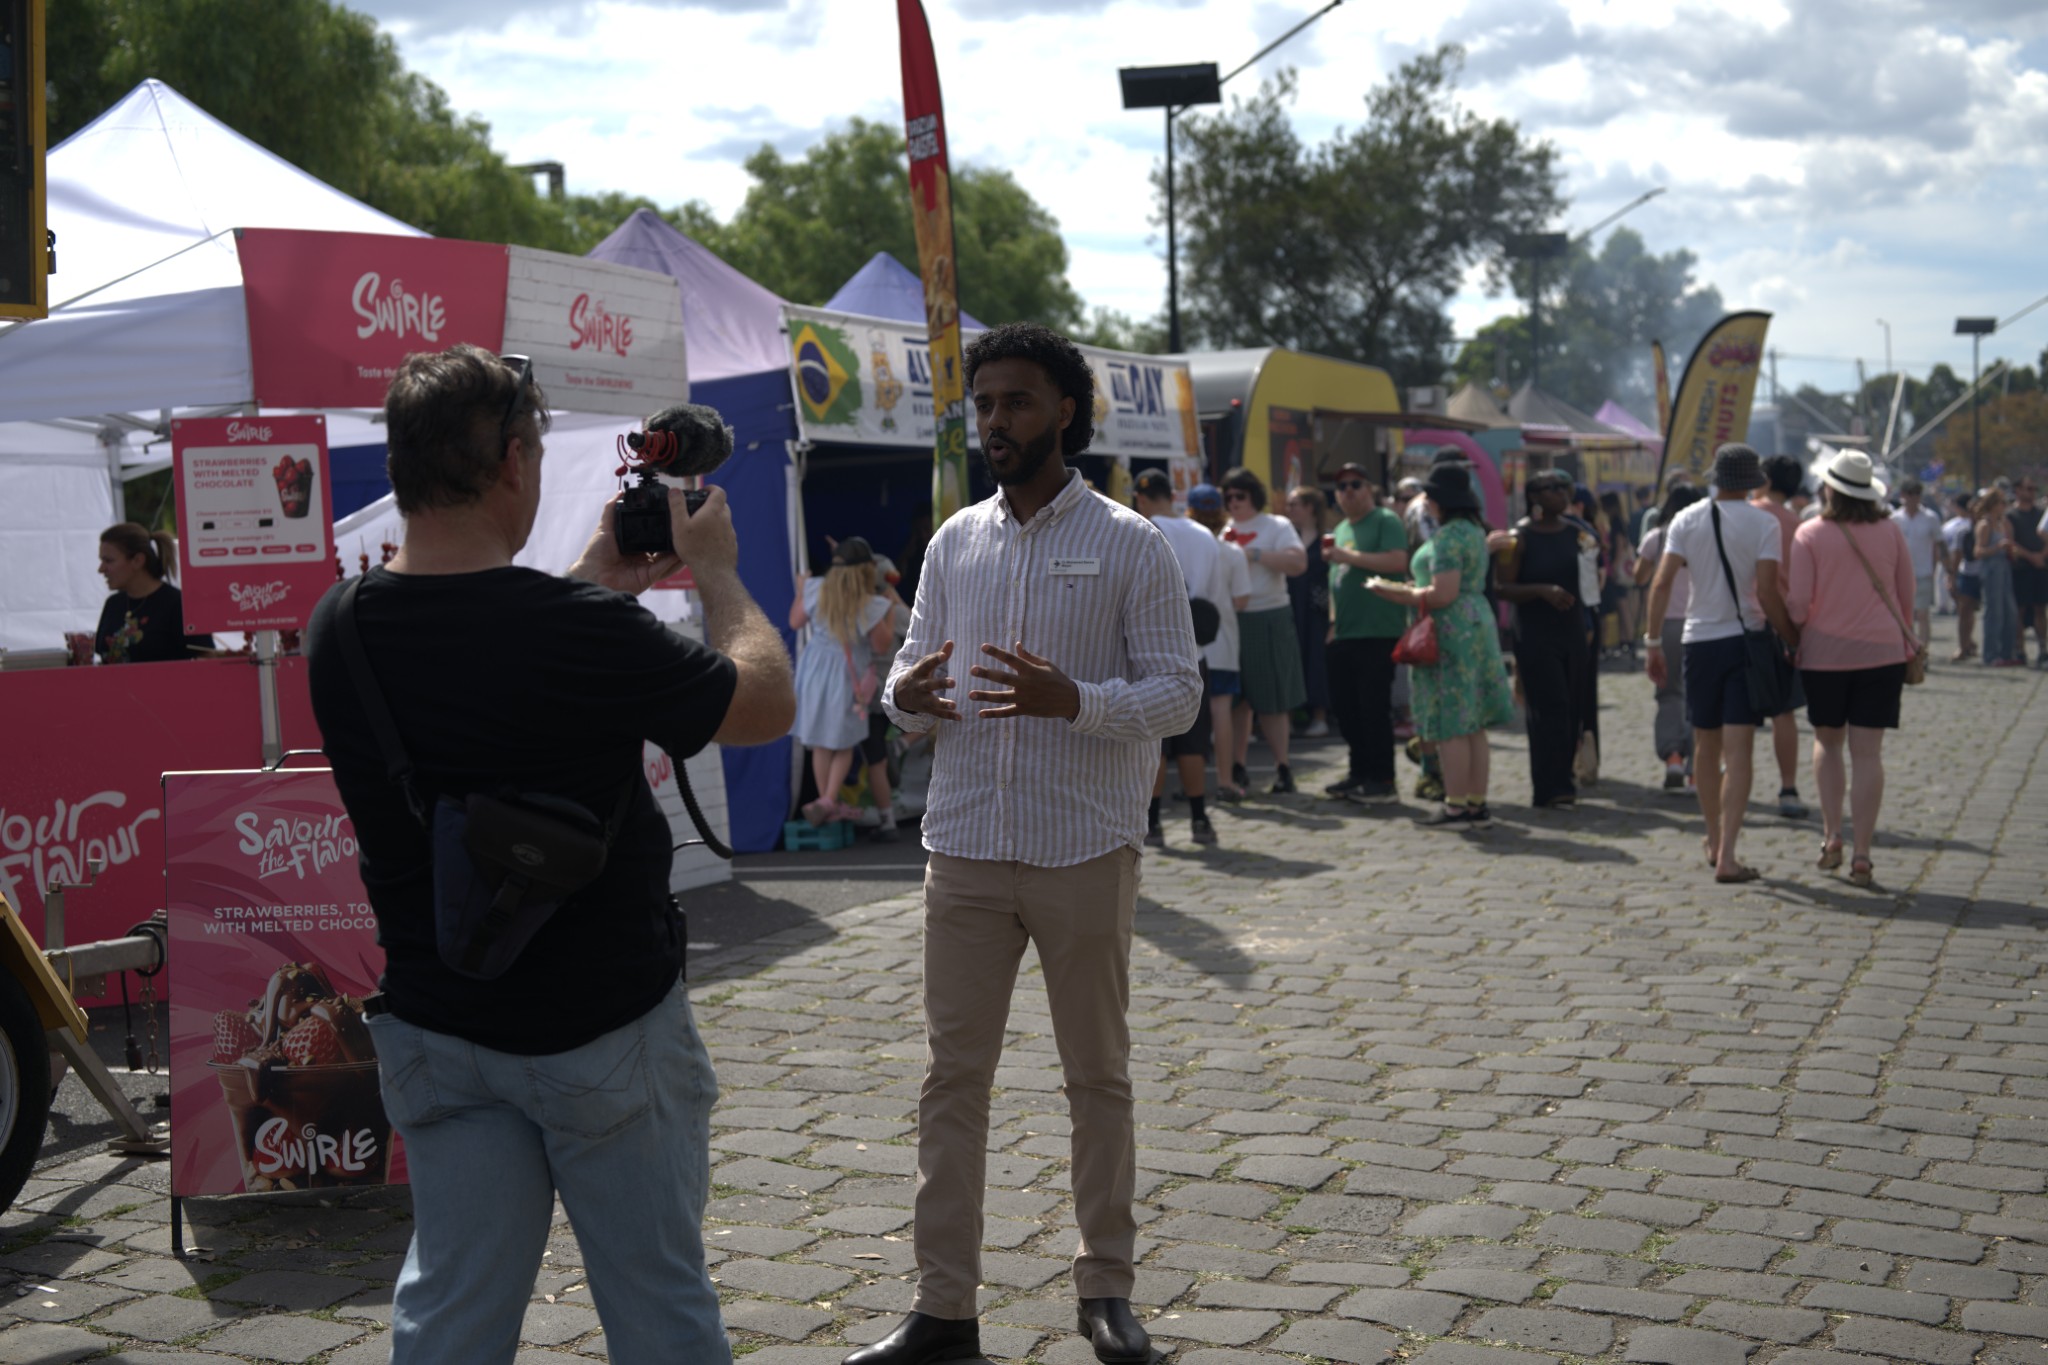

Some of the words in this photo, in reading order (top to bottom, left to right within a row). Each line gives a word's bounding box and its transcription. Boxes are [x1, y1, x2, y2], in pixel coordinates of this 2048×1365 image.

[193, 457, 267, 468] STRAWBERRIES
[193, 469, 219, 479] WITH
[221, 468, 260, 478] MELTED
[194, 479, 254, 490] CHOCOLATE
[234, 811, 350, 856] Savour
[258, 849, 290, 879] the
[214, 903, 343, 919] STRAWBERRIES,
[204, 922, 246, 935] WITH
[251, 919, 314, 933] MELTED
